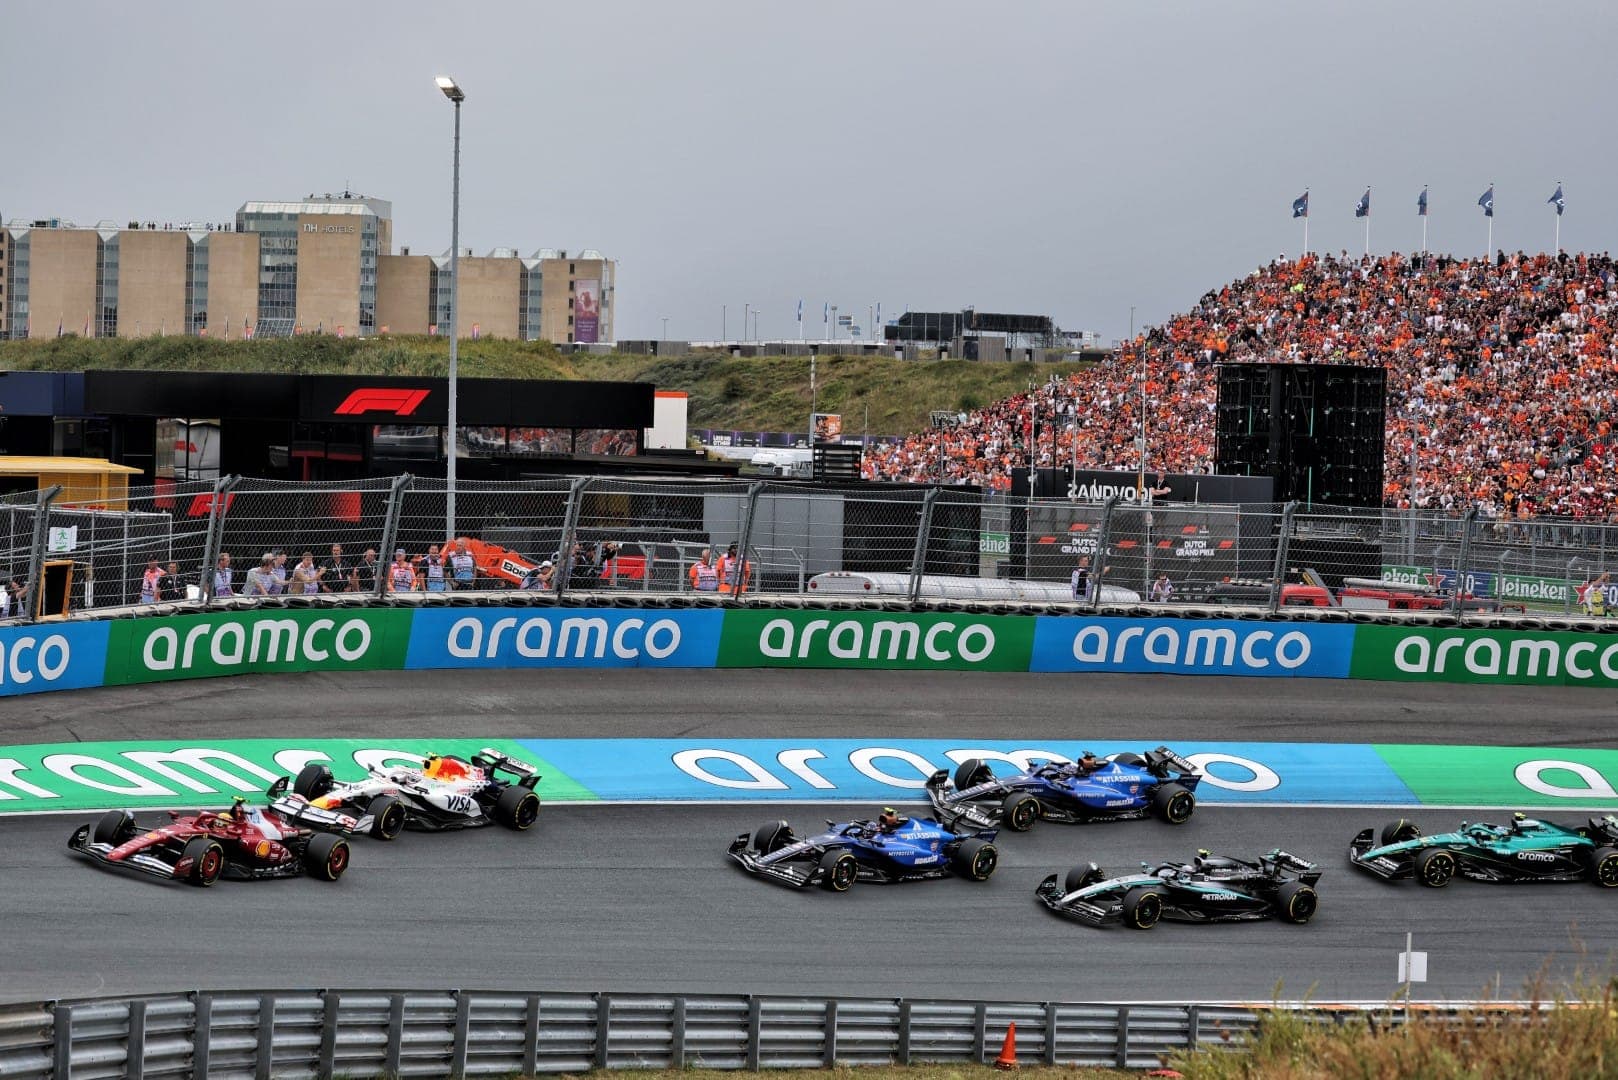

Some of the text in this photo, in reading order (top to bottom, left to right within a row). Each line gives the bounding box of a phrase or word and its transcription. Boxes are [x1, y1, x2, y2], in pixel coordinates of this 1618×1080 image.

[1067, 482, 1153, 502] ZANDVOO
[1061, 545, 1090, 554] GRAND
[503, 561, 529, 578] Boe
[143, 619, 370, 670] aramco
[447, 617, 681, 659] aramco
[759, 619, 995, 662] aramco
[1073, 625, 1311, 668] aramco
[0, 634, 70, 684] co
[1103, 775, 1140, 784] ATLASSIAN
[444, 795, 471, 812] VISA
[907, 831, 941, 840] ATLASSIAN
[1517, 852, 1555, 862] aramco
[1201, 893, 1238, 901] PETRONAS
